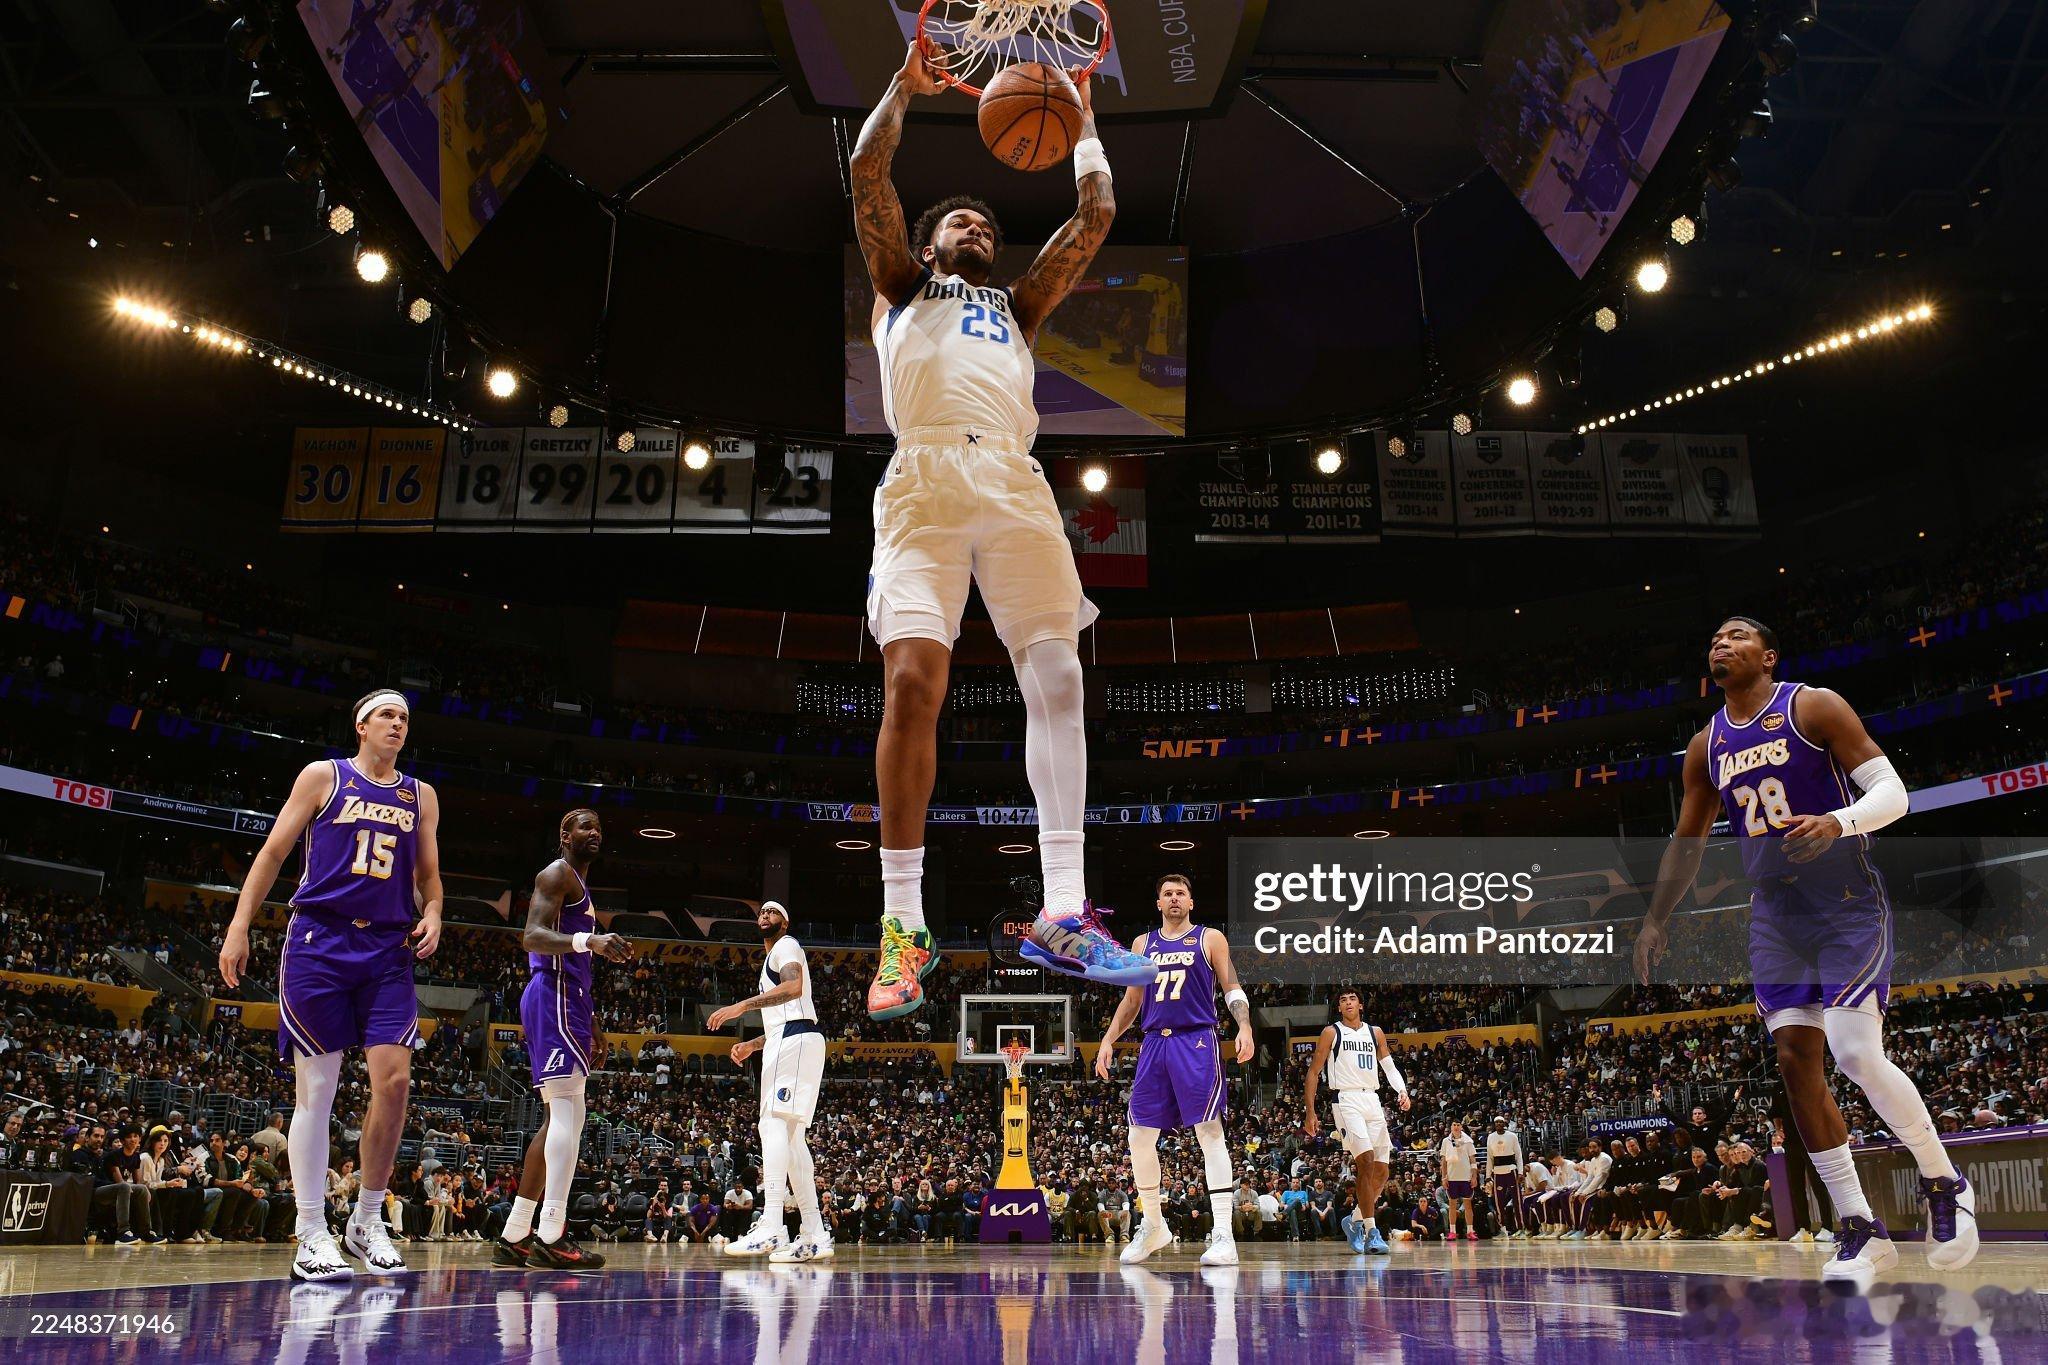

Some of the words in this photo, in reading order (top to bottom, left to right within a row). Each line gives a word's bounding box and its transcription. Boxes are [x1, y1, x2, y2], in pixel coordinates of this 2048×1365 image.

[924, 281, 1006, 313] DALLAS
[961, 303, 1011, 345] 25
[303, 439, 357, 452] VACHON
[380, 439, 434, 452] DIONNE
[527, 440, 593, 453] GRETZKY
[1688, 445, 1737, 459] MILLER
[1390, 468, 1438, 479] WESTERN
[1466, 469, 1516, 480] WESTERN
[1541, 468, 1592, 480] CAMPBELL
[1622, 468, 1662, 479] SMYTHE
[295, 464, 351, 505] 30
[377, 464, 422, 505] 16
[456, 464, 502, 504] 18
[528, 463, 588, 505] 99
[605, 463, 666, 505] 20
[699, 465, 728, 506] 4
[766, 466, 820, 508] 23
[1292, 483, 1342, 495] STANLEY
[1346, 483, 1373, 494] CUP
[1383, 480, 1447, 491] CONFERENCE
[1460, 480, 1525, 491] CONFERENCE
[1536, 480, 1600, 491] CONFERENCE
[1622, 480, 1667, 491] DIVISION
[1199, 495, 1280, 509] CHAMPIONS
[1292, 496, 1373, 509] CHAMPIONS
[1388, 491, 1445, 502] CHAMPIONS
[1464, 492, 1522, 503] CHAMPIONS
[1541, 491, 1598, 502] CHAMPIONS
[1615, 491, 1674, 502] CHAMPIONS
[1396, 505, 1439, 517] 2013-14
[1474, 505, 1517, 518] 2011-12
[1548, 505, 1594, 518] 1992-93
[1623, 505, 1669, 518] 1990-91
[1211, 513, 1271, 529] 2013-14
[1304, 514, 1362, 529] 2011-12
[1717, 738, 1791, 791] LAKERS
[143, 797, 174, 811] Andrew
[175, 802, 208, 816] Ramirez
[1731, 776, 1793, 838] 28
[332, 795, 416, 833] LAKERS
[816, 810, 823, 820] 7
[832, 811, 839, 821] 0
[932, 811, 966, 821] Lakers
[981, 808, 1030, 824] 10:47
[1120, 808, 1130, 823] 0
[1187, 811, 1195, 821] 0
[1204, 811, 1212, 821] 7
[241, 816, 267, 832] 7:20
[351, 829, 398, 880] 15
[1150, 952, 1195, 967] LAKERS
[1154, 969, 1187, 1003] 77
[1342, 1040, 1374, 1053] DALLAS
[541, 1047, 566, 1073] LA
[1357, 1053, 1374, 1071] 00
[1599, 1121, 1614, 1133] 17x
[1614, 1116, 1669, 1130] CHAMPIONS
[27, 1201, 48, 1212] prime
